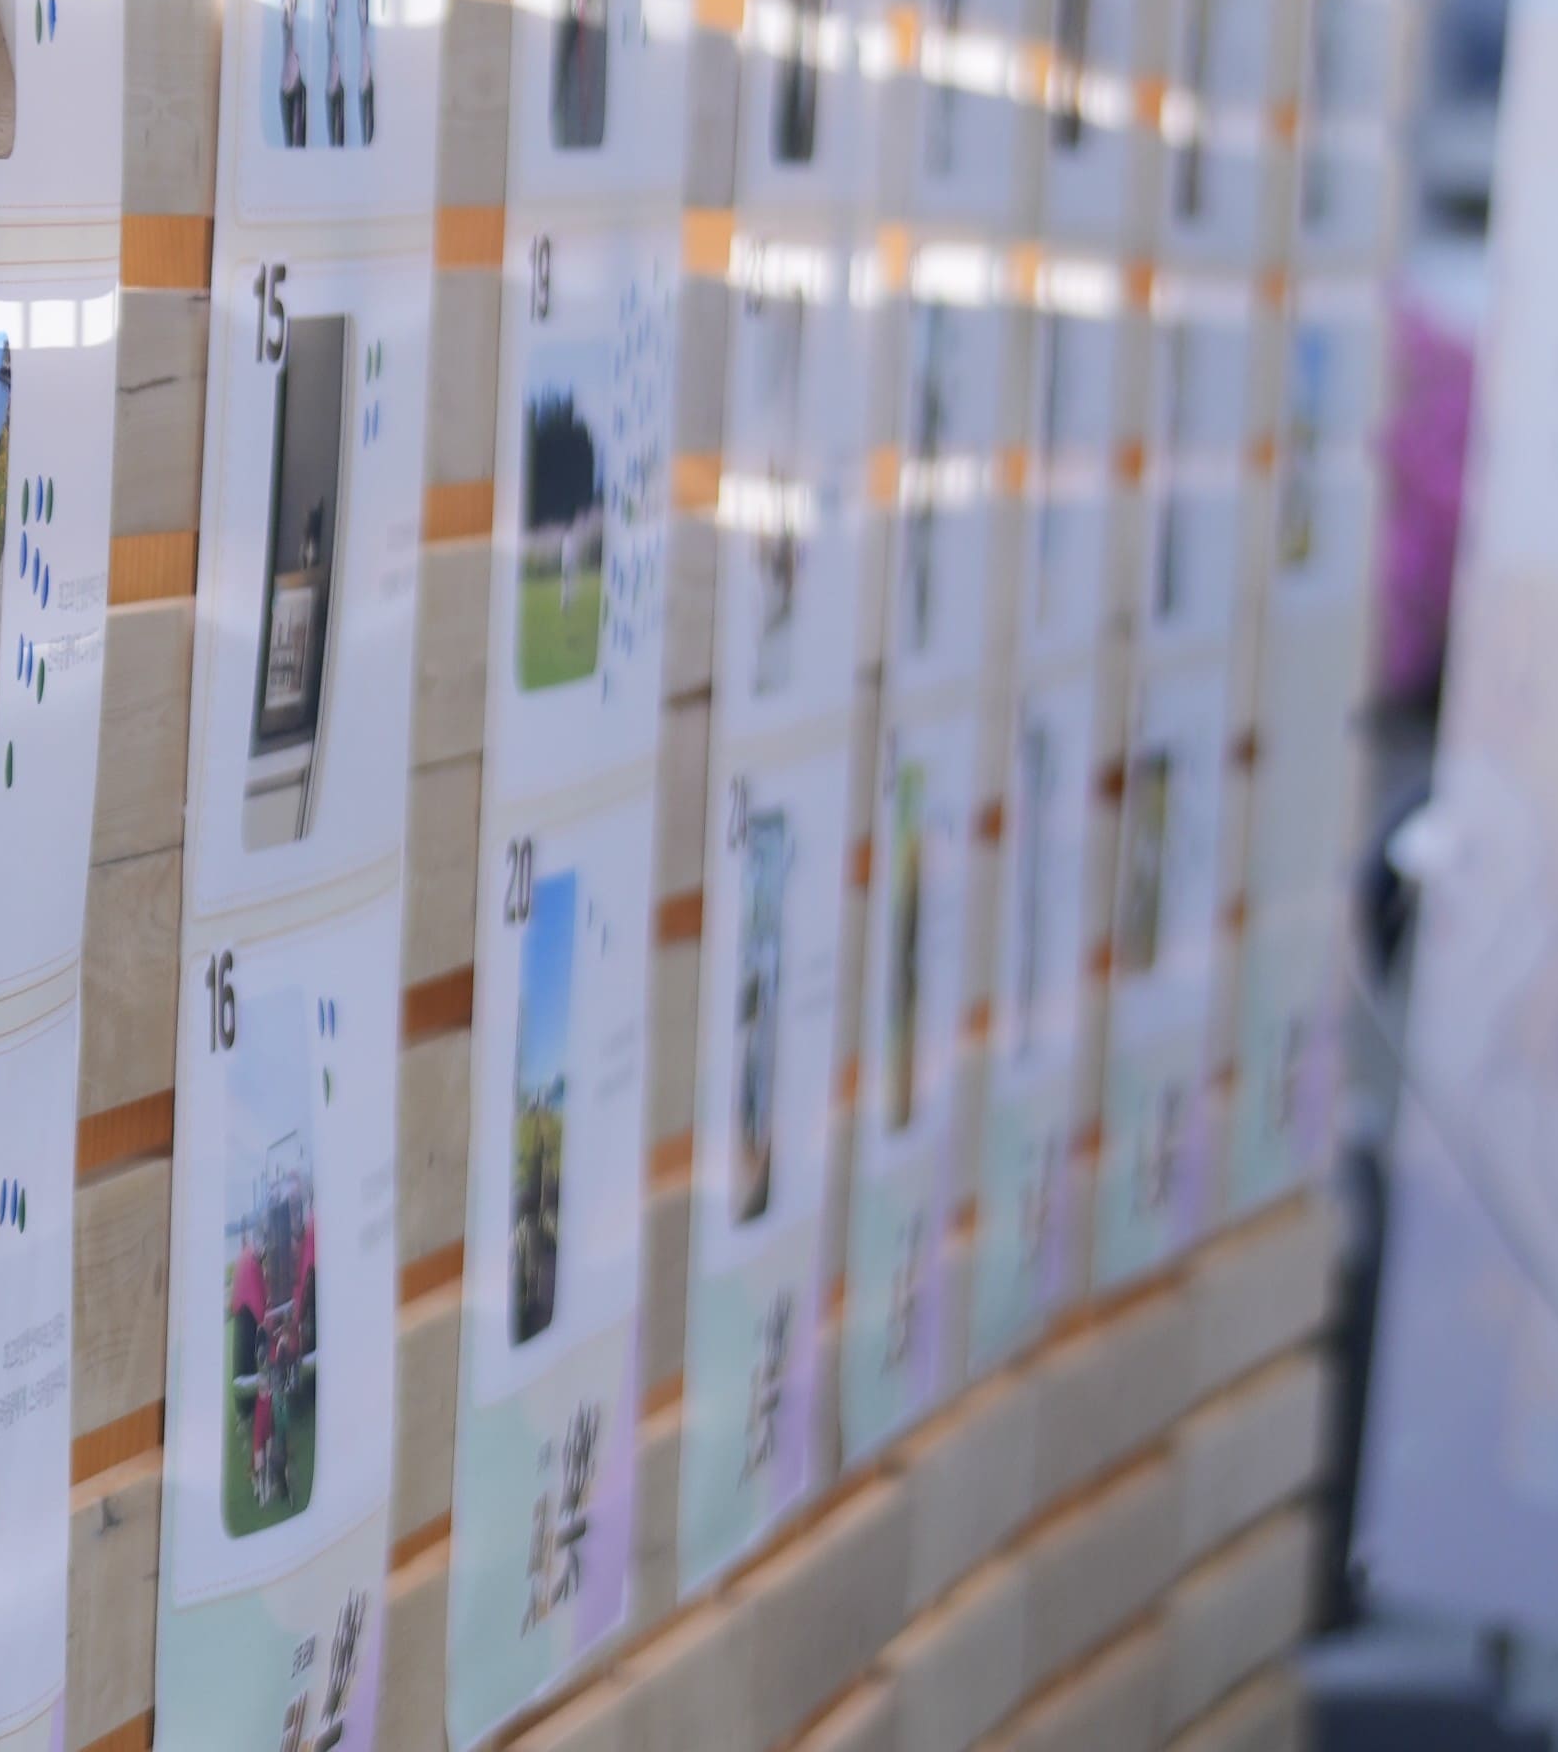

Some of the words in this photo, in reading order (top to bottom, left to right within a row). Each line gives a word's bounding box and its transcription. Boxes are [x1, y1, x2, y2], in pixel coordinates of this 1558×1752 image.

[254, 263, 287, 363] 15
[529, 233, 550, 322] 19
[505, 839, 532, 924] 20
[205, 950, 235, 1053] 16
